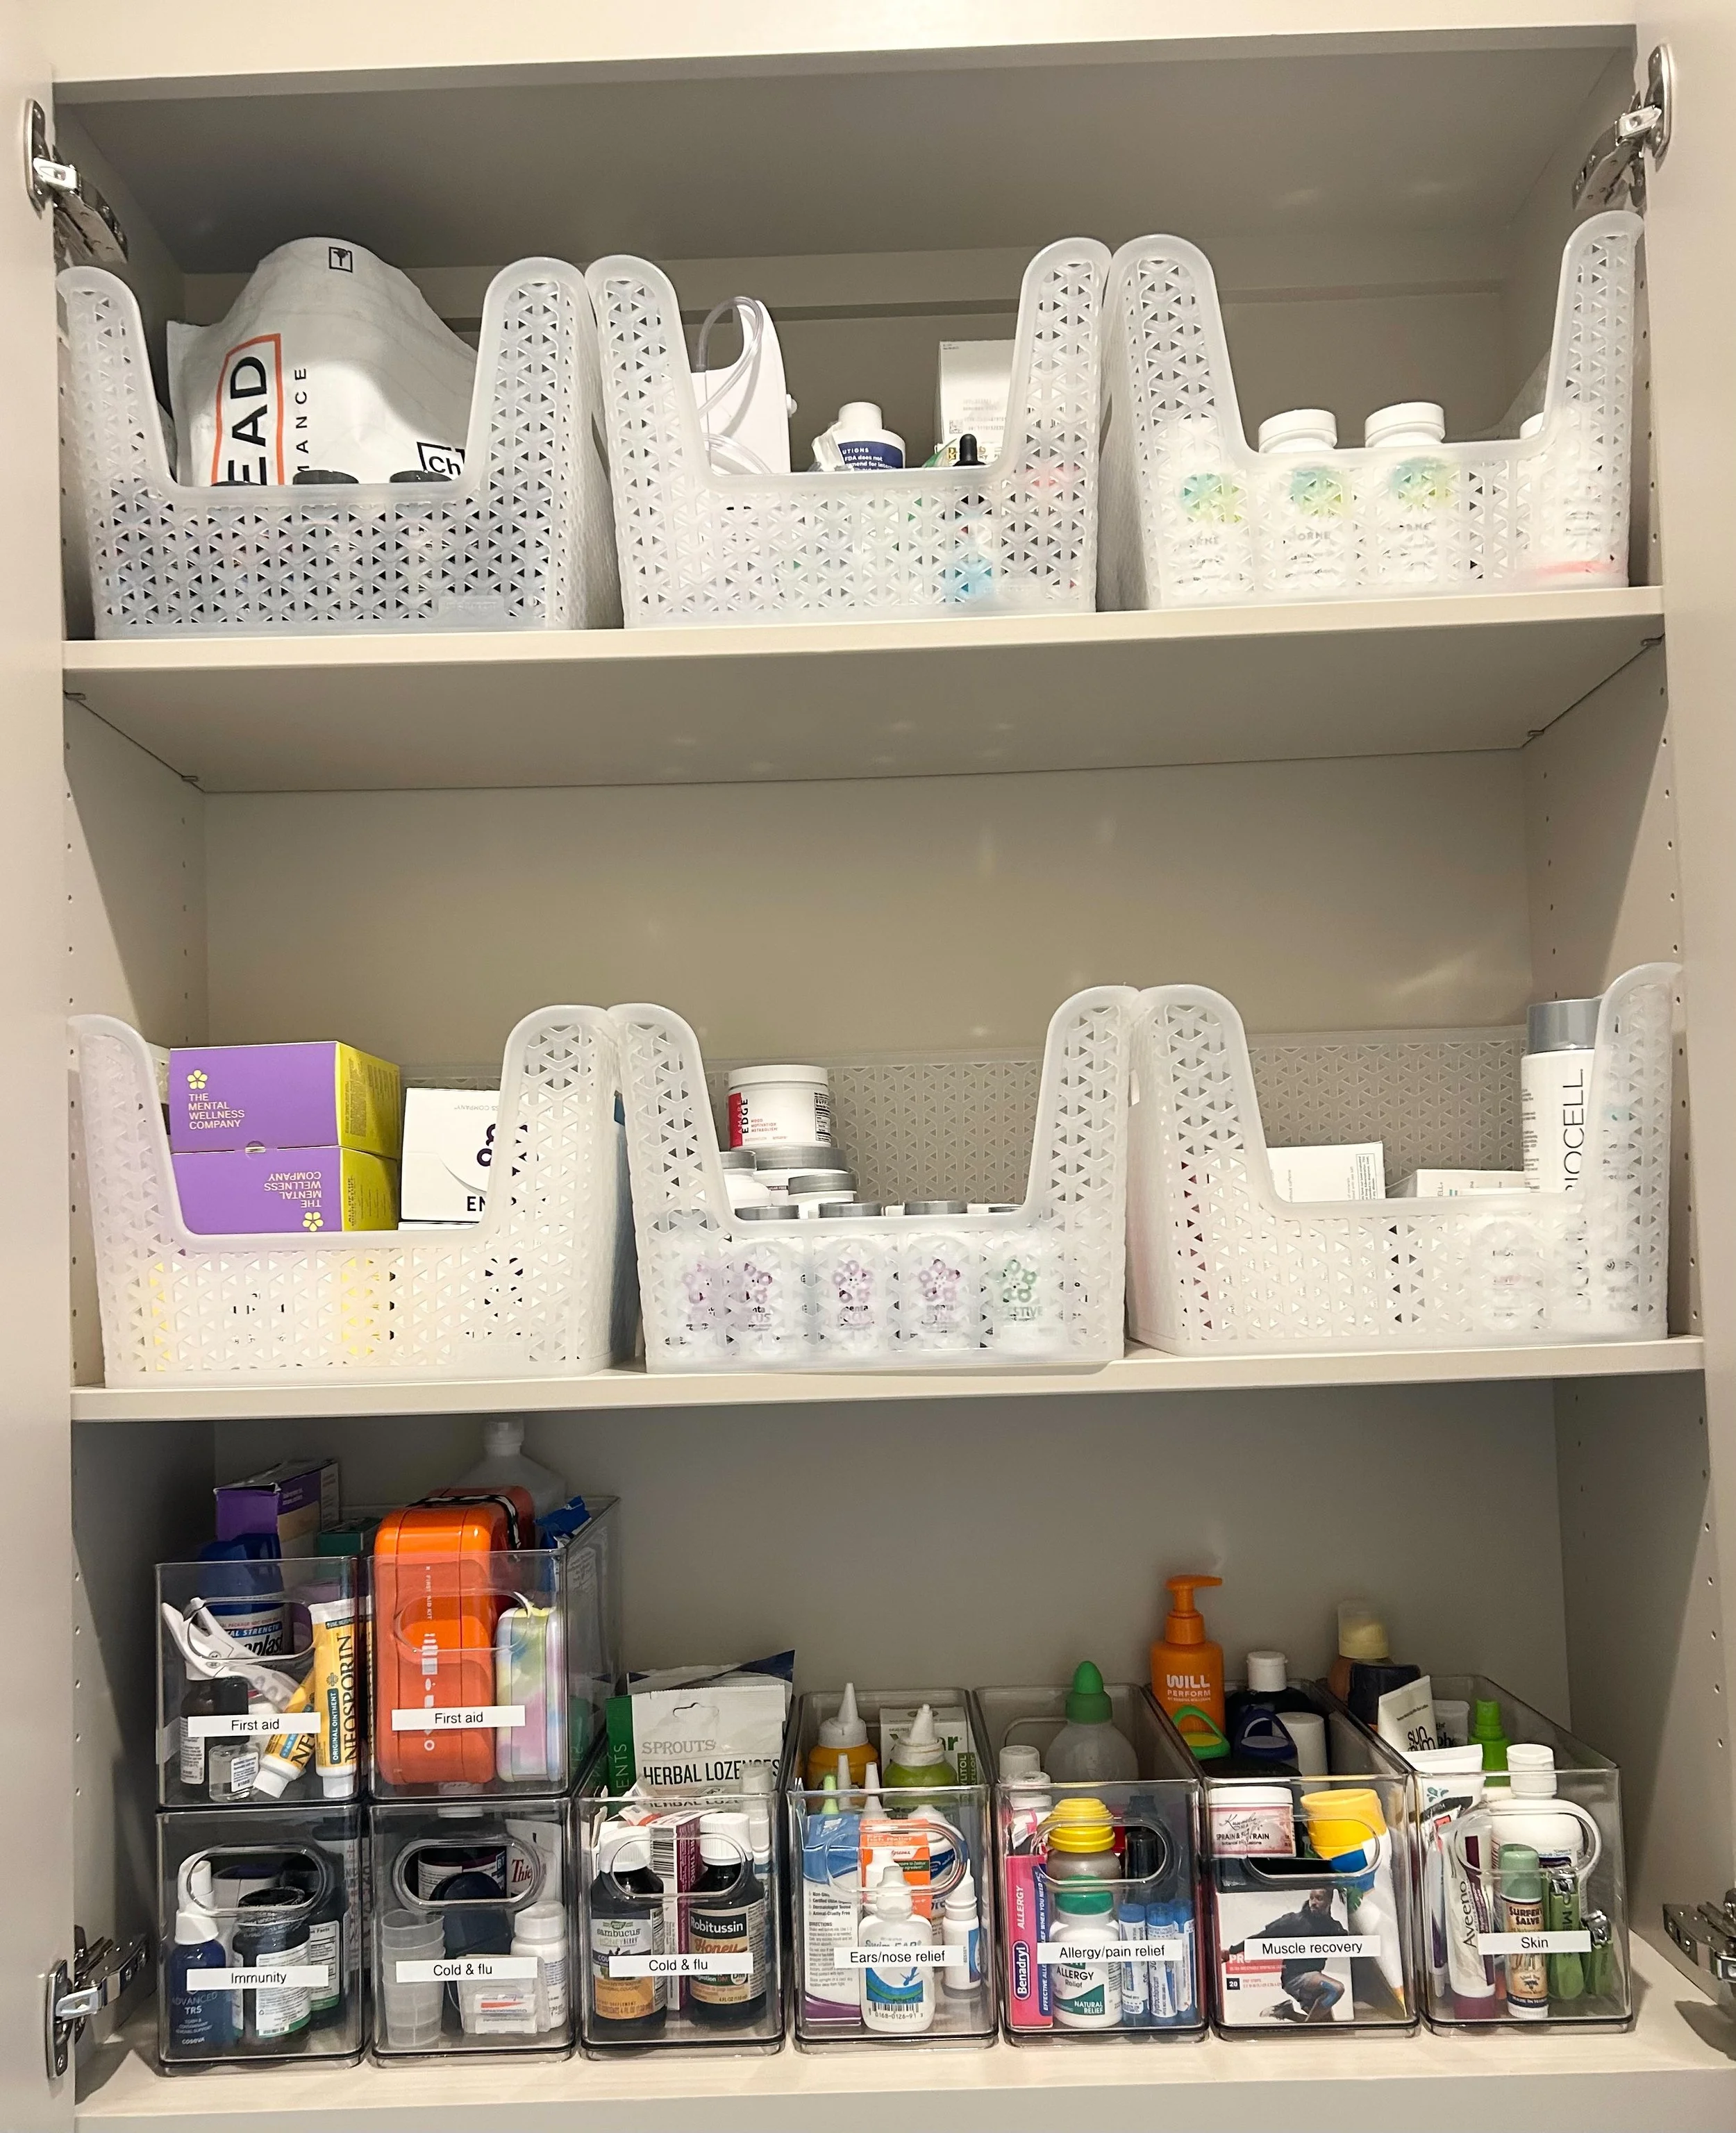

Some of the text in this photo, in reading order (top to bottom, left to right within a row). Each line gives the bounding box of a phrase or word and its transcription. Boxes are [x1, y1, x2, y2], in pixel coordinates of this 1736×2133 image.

[188, 1094, 208, 1102] THE
[187, 1101, 230, 1110] MENTAL
[188, 1110, 245, 1120] WELLNESS
[741, 1099, 749, 1134] EDGE
[189, 1119, 241, 1130] COMPANY
[268, 1171, 322, 1181] COMPANY
[264, 1182, 322, 1191] WELLNESS
[281, 1191, 322, 1200] MENTAL
[301, 1199, 322, 1207] THE
[1166, 1674, 1210, 1689] WILL
[337, 1634, 357, 1764] NEOSPORIN
[1167, 1689, 1211, 1697] PERFORM
[434, 1711, 483, 1723] First aid
[231, 1718, 280, 1731] First aid
[1407, 1726, 1428, 1745] sun
[642, 1739, 717, 1756] SPROUTS
[643, 1759, 781, 1785] HERBAL LOZES
[511, 1859, 533, 1882] Thie
[1015, 1885, 1026, 1930] ALLERGY
[1460, 1880, 1478, 1949] Aveeno
[1515, 1916, 1540, 1925] SALVE
[690, 1916, 744, 1933] Robitussin
[596, 1927, 640, 1938] sambucus
[694, 1937, 739, 1952] Honey
[1262, 1941, 1362, 1955] Muscle recovery
[1521, 1937, 1549, 1949] Skin
[850, 1950, 946, 1964] Ears/nose relief
[1059, 1945, 1165, 1959] Allergy/pain relief
[1228, 1953, 1251, 1964] PR
[433, 1963, 492, 1977] Cold & flu
[649, 1959, 708, 1971] Cold & flu
[1016, 1946, 1028, 1995] Benadryl
[231, 1972, 287, 1984] Immunity
[1056, 1966, 1094, 1980] ALLERGY
[1065, 1980, 1083, 1988] Relief
[184, 2005, 202, 2015] TRS
